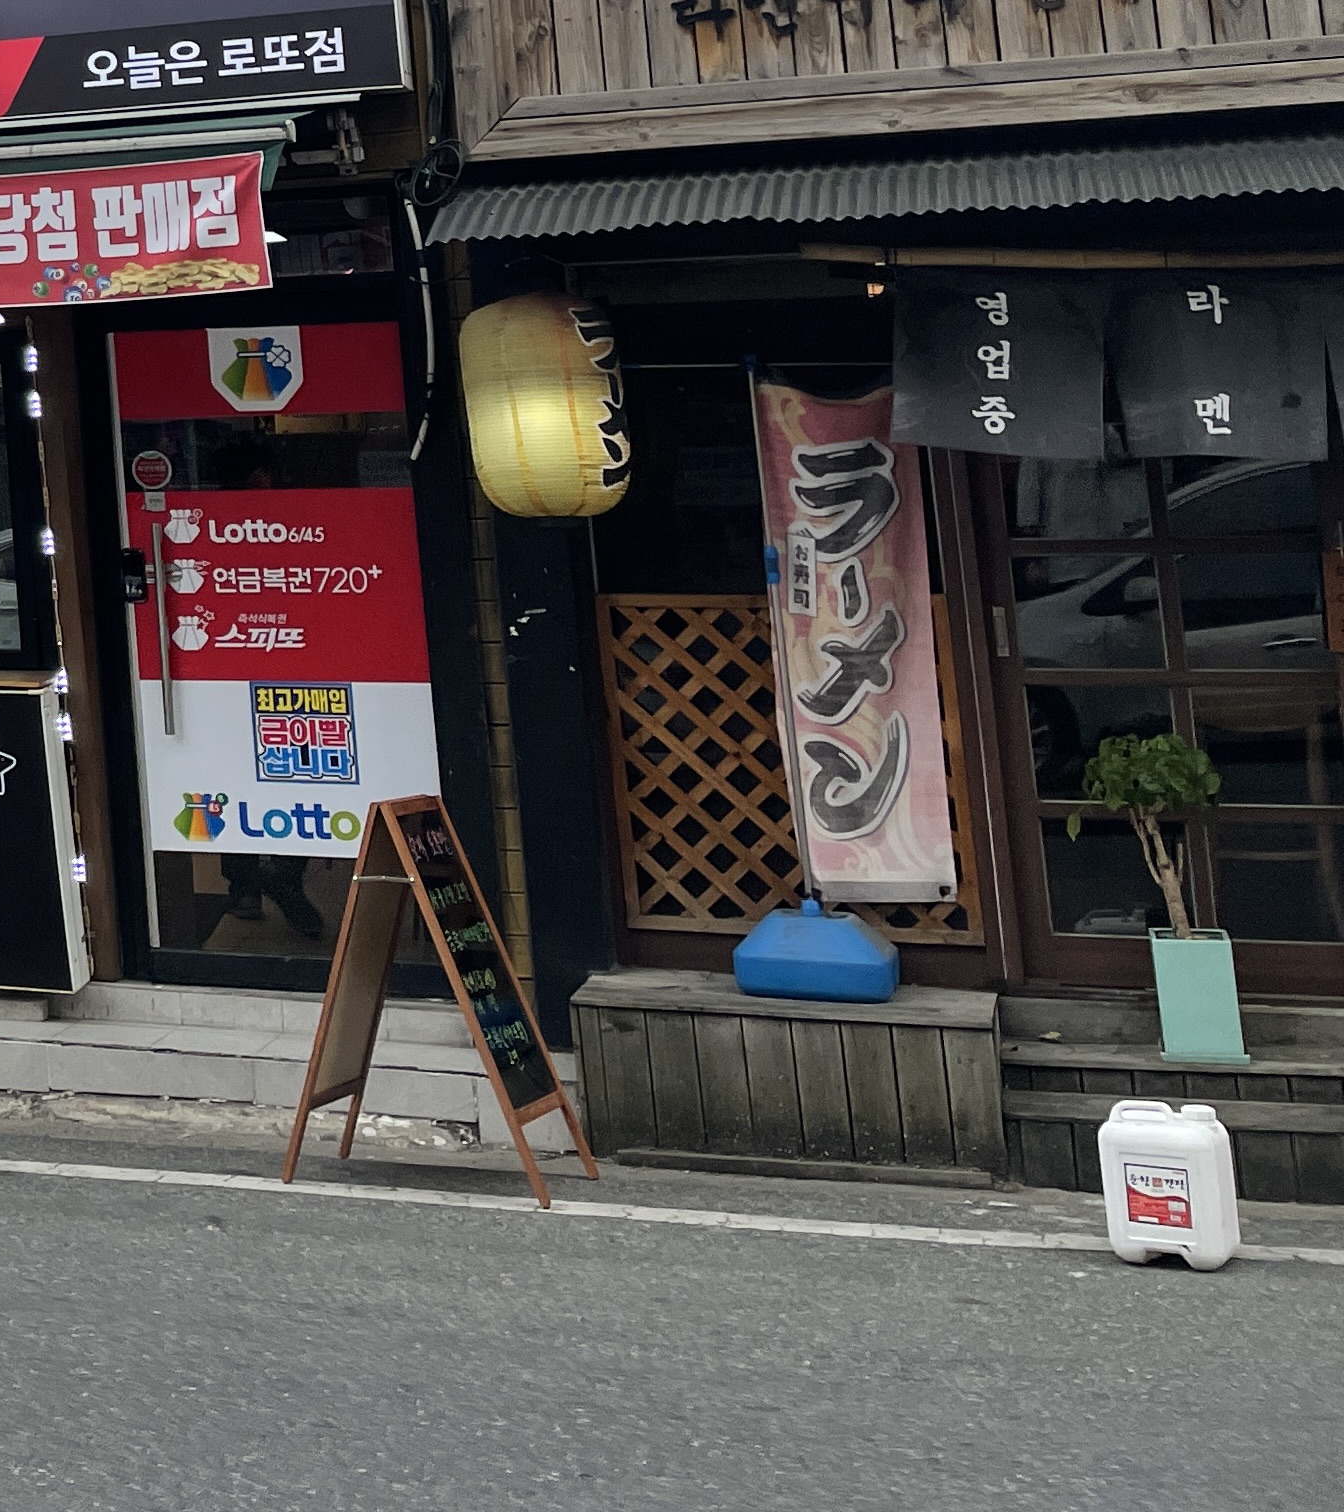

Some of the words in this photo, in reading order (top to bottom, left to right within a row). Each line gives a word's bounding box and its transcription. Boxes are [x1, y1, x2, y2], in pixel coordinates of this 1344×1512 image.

[84, 39, 208, 94] 오늘은
[217, 26, 348, 80] 로또점
[92, 175, 240, 259] 판매점
[971, 291, 1017, 435] 영업중
[1185, 283, 1232, 438] 라멘
[214, 624, 307, 652] 스피또
[791, 438, 909, 841] ラーメン
[256, 687, 347, 713] 최고가매입
[261, 718, 349, 747] 금이빨
[262, 747, 351, 777] 삽니다
[238, 801, 361, 841] Lotto
